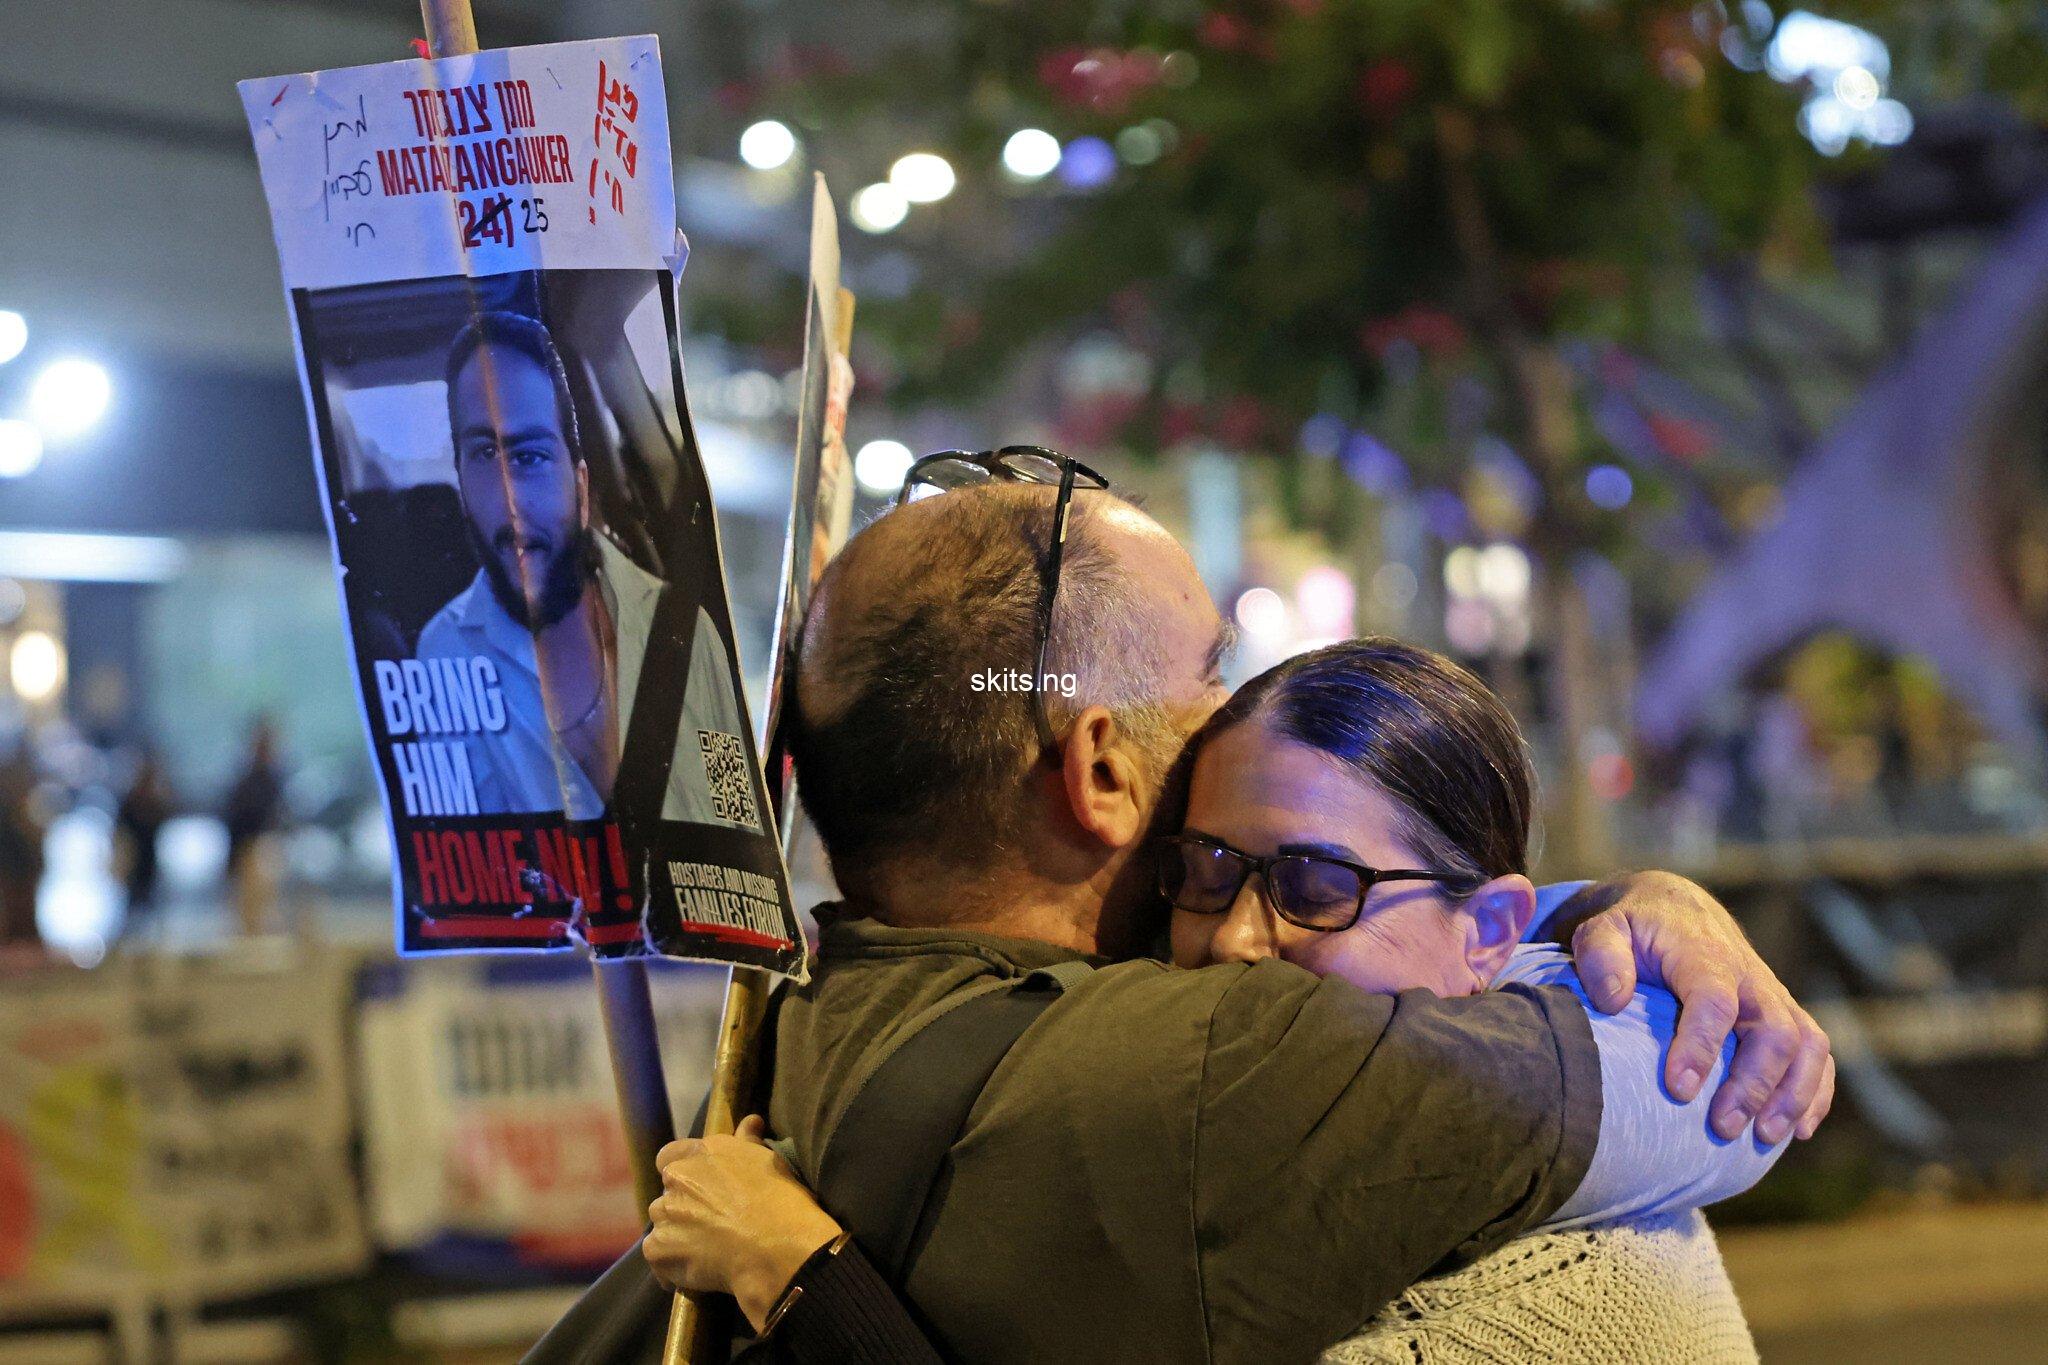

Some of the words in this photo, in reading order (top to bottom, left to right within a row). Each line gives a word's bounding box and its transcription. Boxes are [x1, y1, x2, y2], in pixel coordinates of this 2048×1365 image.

[493, 80, 536, 134] מתן
[377, 144, 450, 197] MATA
[521, 198, 549, 233] 25
[374, 655, 508, 736] BRING
[391, 741, 481, 816] HIM
[413, 828, 534, 906] HOME
[667, 861, 725, 889] HOSTAGES
[722, 866, 744, 893] AND
[741, 870, 780, 903] MISSING
[674, 887, 745, 929] FAMILIES
[741, 895, 789, 942] FORUM
